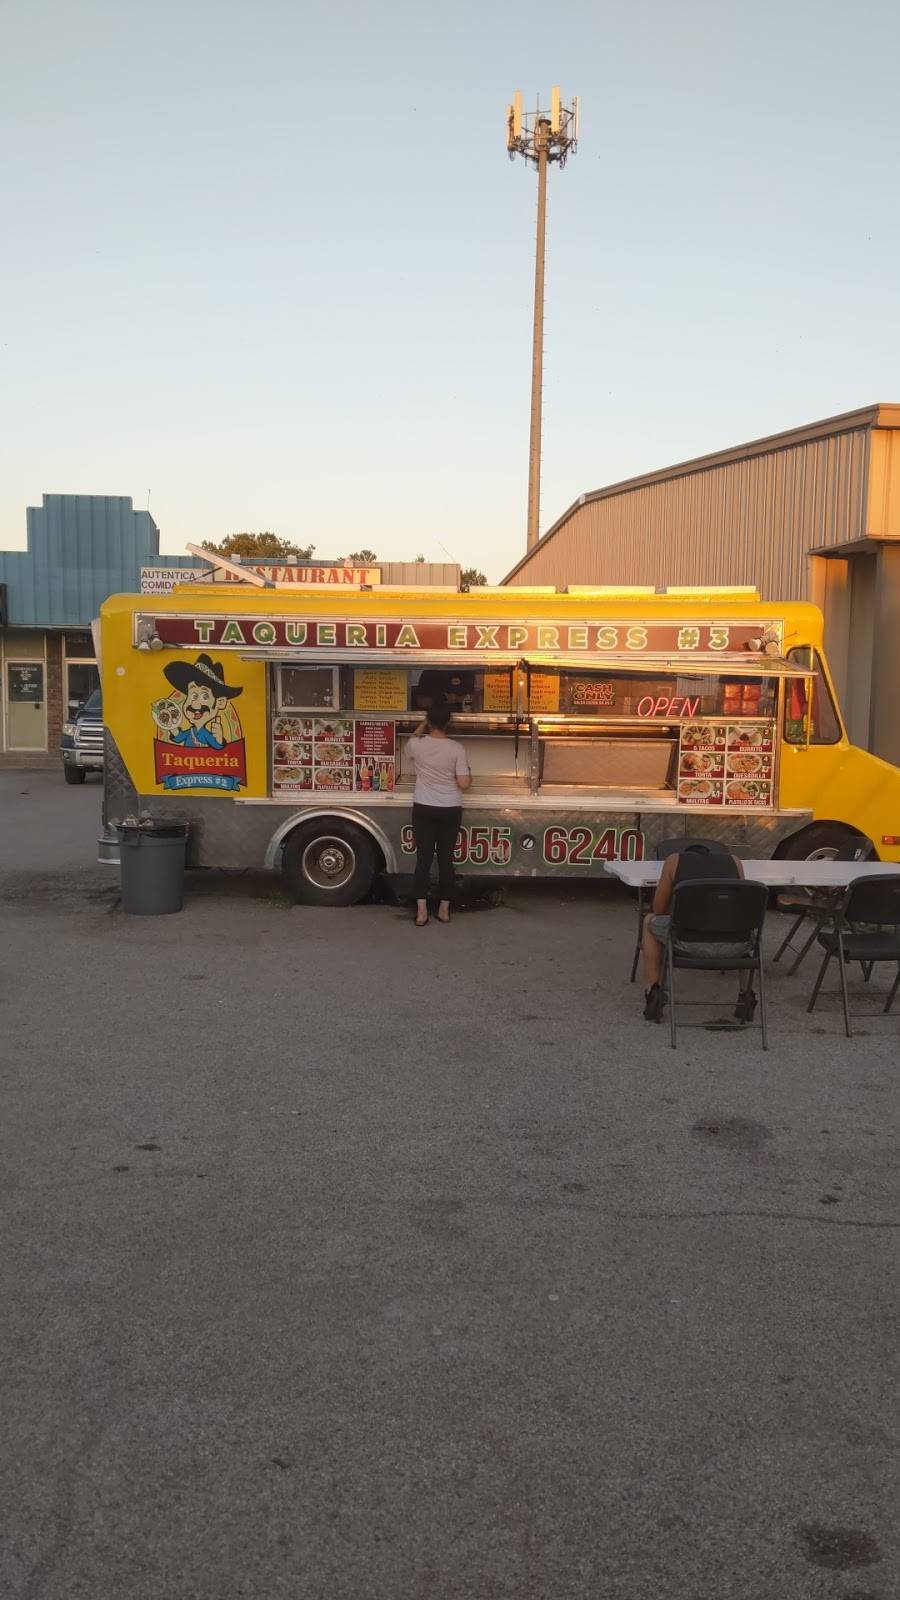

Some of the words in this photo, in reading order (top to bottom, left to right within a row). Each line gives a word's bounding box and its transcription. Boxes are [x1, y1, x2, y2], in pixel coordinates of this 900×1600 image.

[141, 570, 196, 580] AUTENTICA
[194, 620, 420, 648] TAQUERIA
[447, 625, 648, 650] EXPRESS
[677, 626, 729, 650] #3
[575, 683, 613, 692] CASH
[574, 690, 614, 701] ONLY
[637, 696, 700, 717] OPEN
[162, 752, 239, 769] Taqueria
[175, 775, 213, 787] Express
[543, 825, 645, 866] 6240
